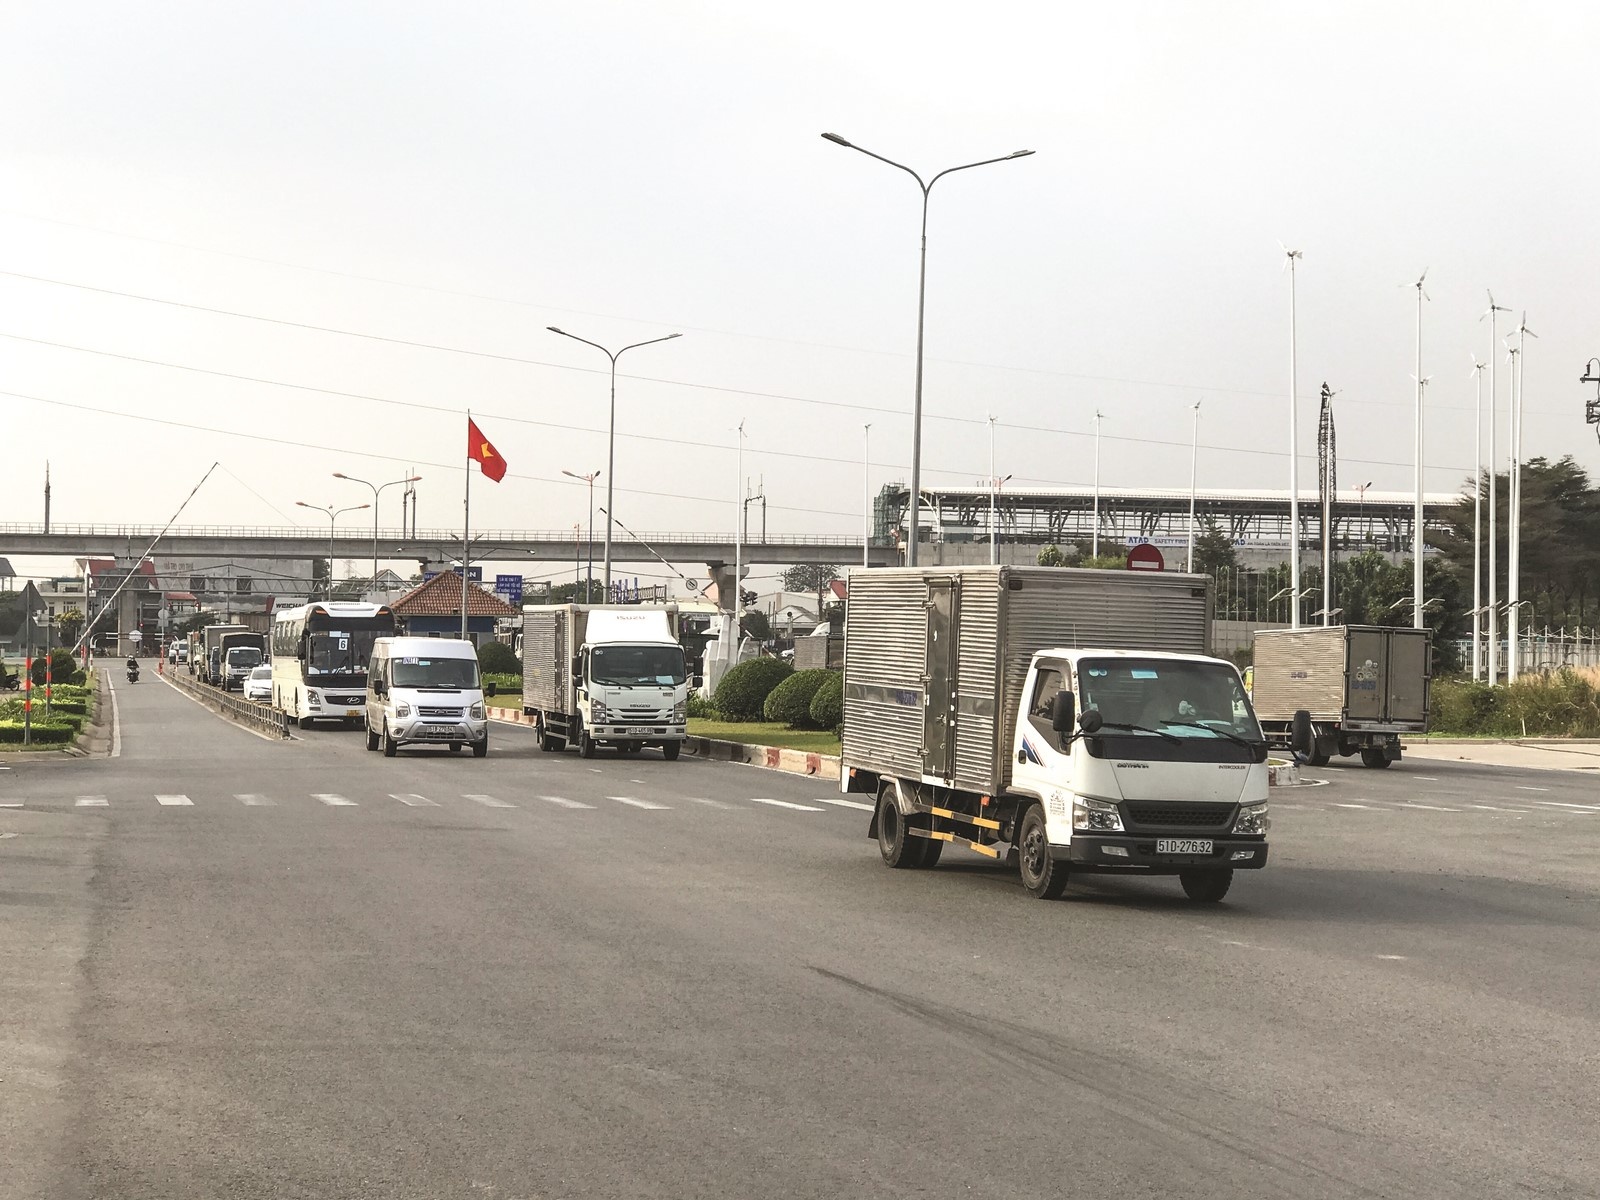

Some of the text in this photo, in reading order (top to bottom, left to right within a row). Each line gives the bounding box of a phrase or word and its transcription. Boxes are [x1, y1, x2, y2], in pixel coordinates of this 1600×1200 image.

[1128, 536, 1149, 544] ATAD
[340, 640, 346, 649] 6
[1158, 840, 1212, 853] 51D-276.32
